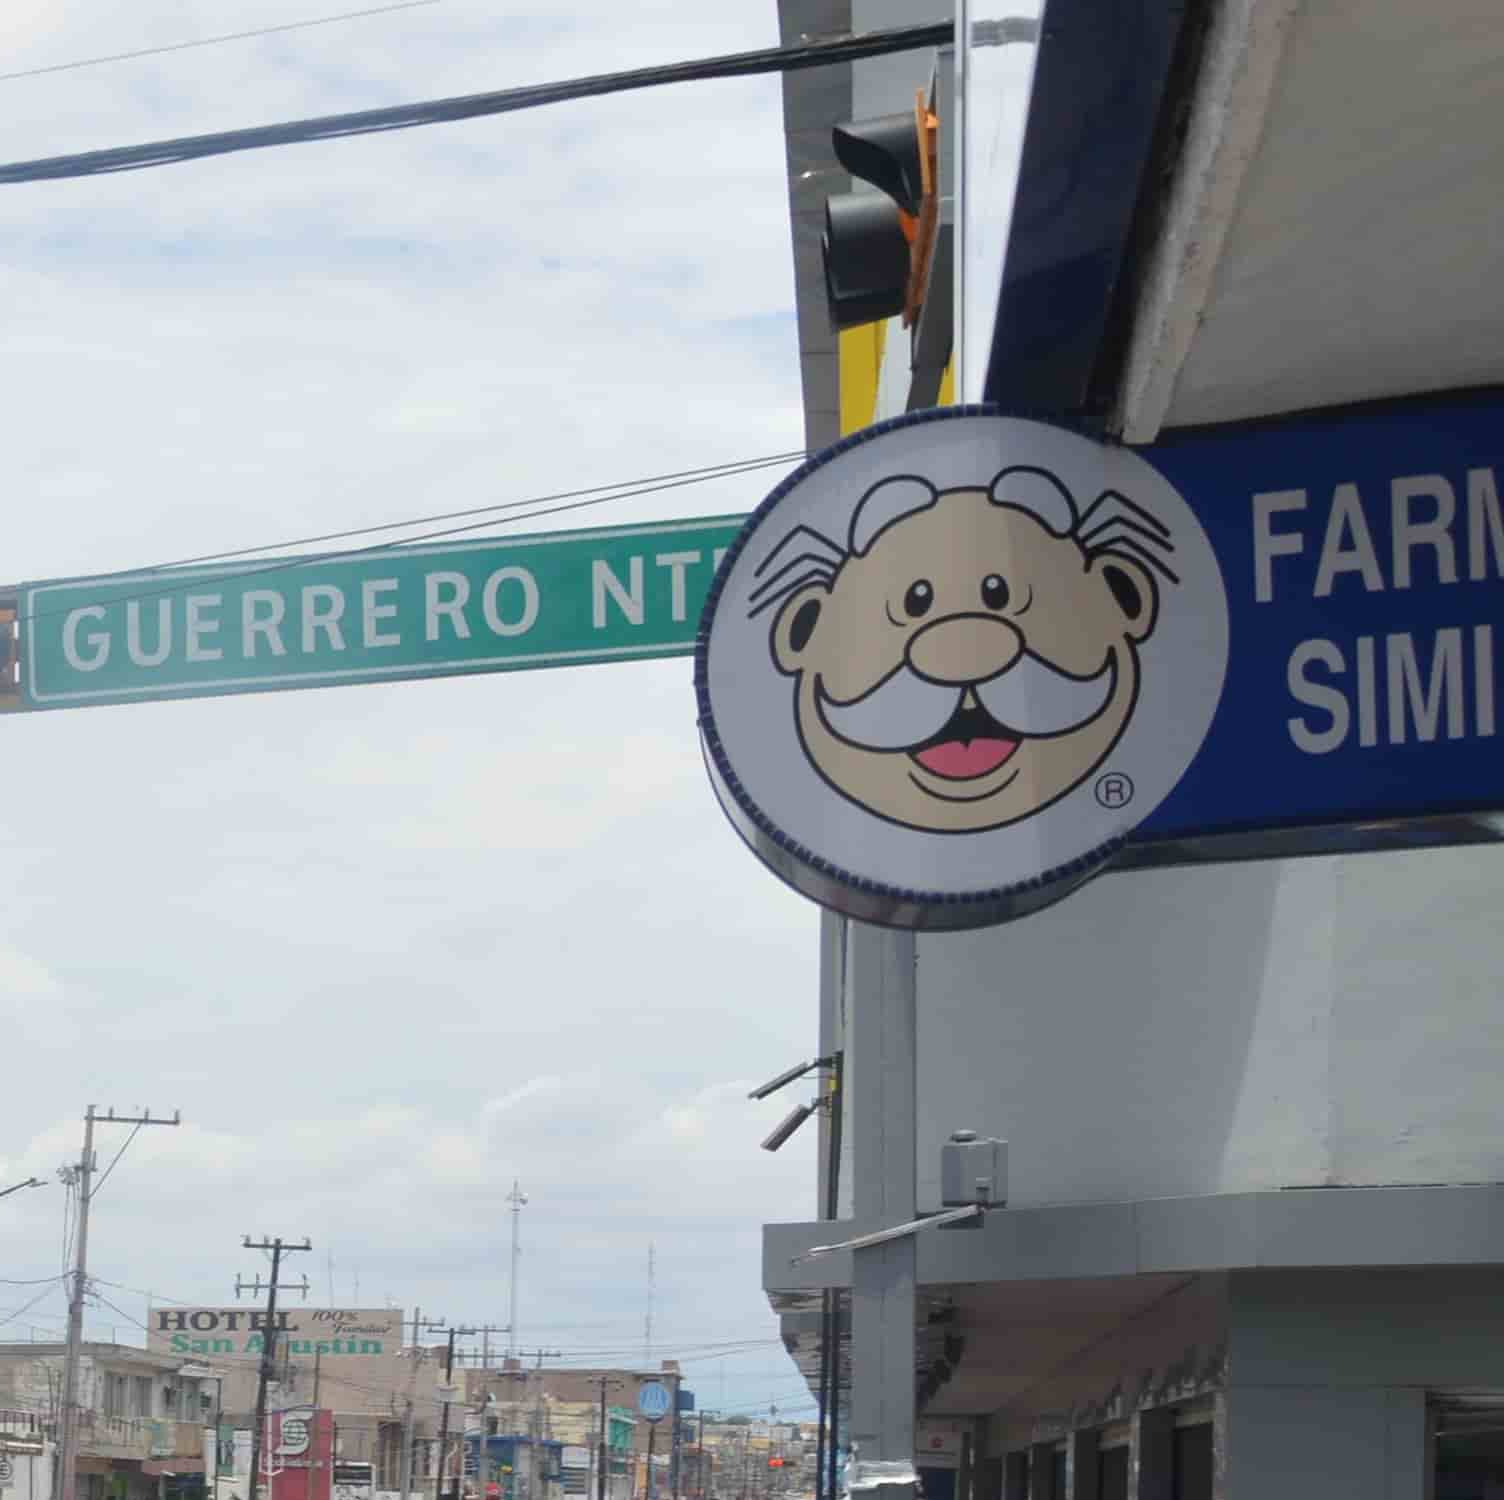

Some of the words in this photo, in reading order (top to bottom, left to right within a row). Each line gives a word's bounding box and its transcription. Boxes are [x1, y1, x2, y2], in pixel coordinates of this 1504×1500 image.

[62, 565, 540, 671] GUERRERO
[592, 547, 729, 629] NT
[170, 1333, 234, 1353] San
